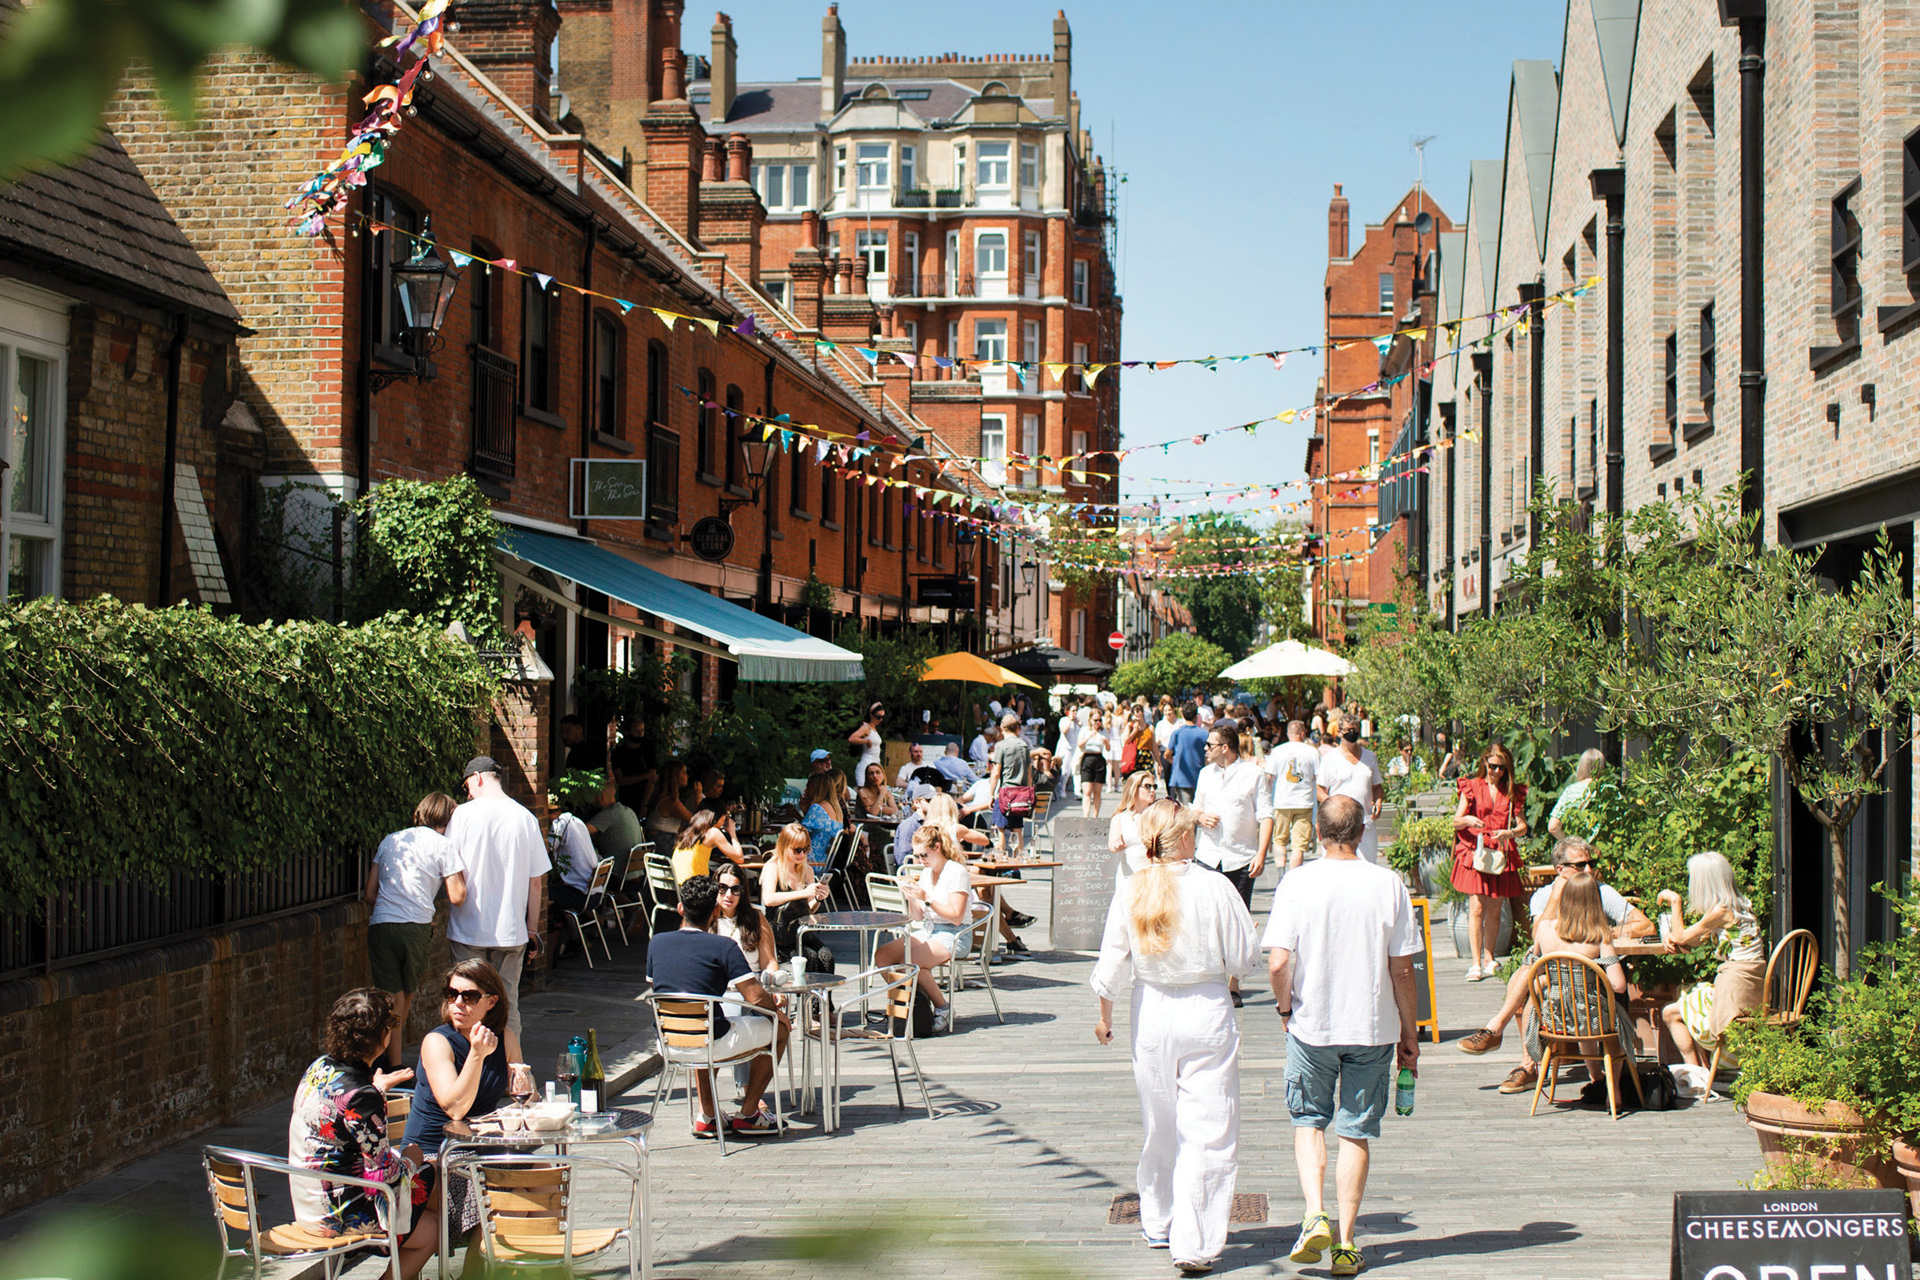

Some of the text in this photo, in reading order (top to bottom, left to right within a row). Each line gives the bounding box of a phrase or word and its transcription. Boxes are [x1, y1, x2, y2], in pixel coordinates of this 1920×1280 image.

[603, 489, 622, 501] The
[696, 534, 729, 543] GENERAL
[701, 542, 724, 551] STORE
[1075, 870, 1103, 878] CLAMS
[1085, 882, 1109, 890] DORY
[1763, 1202, 1818, 1213] LONDON
[1686, 1218, 1904, 1240] CHEESEMONGERS
